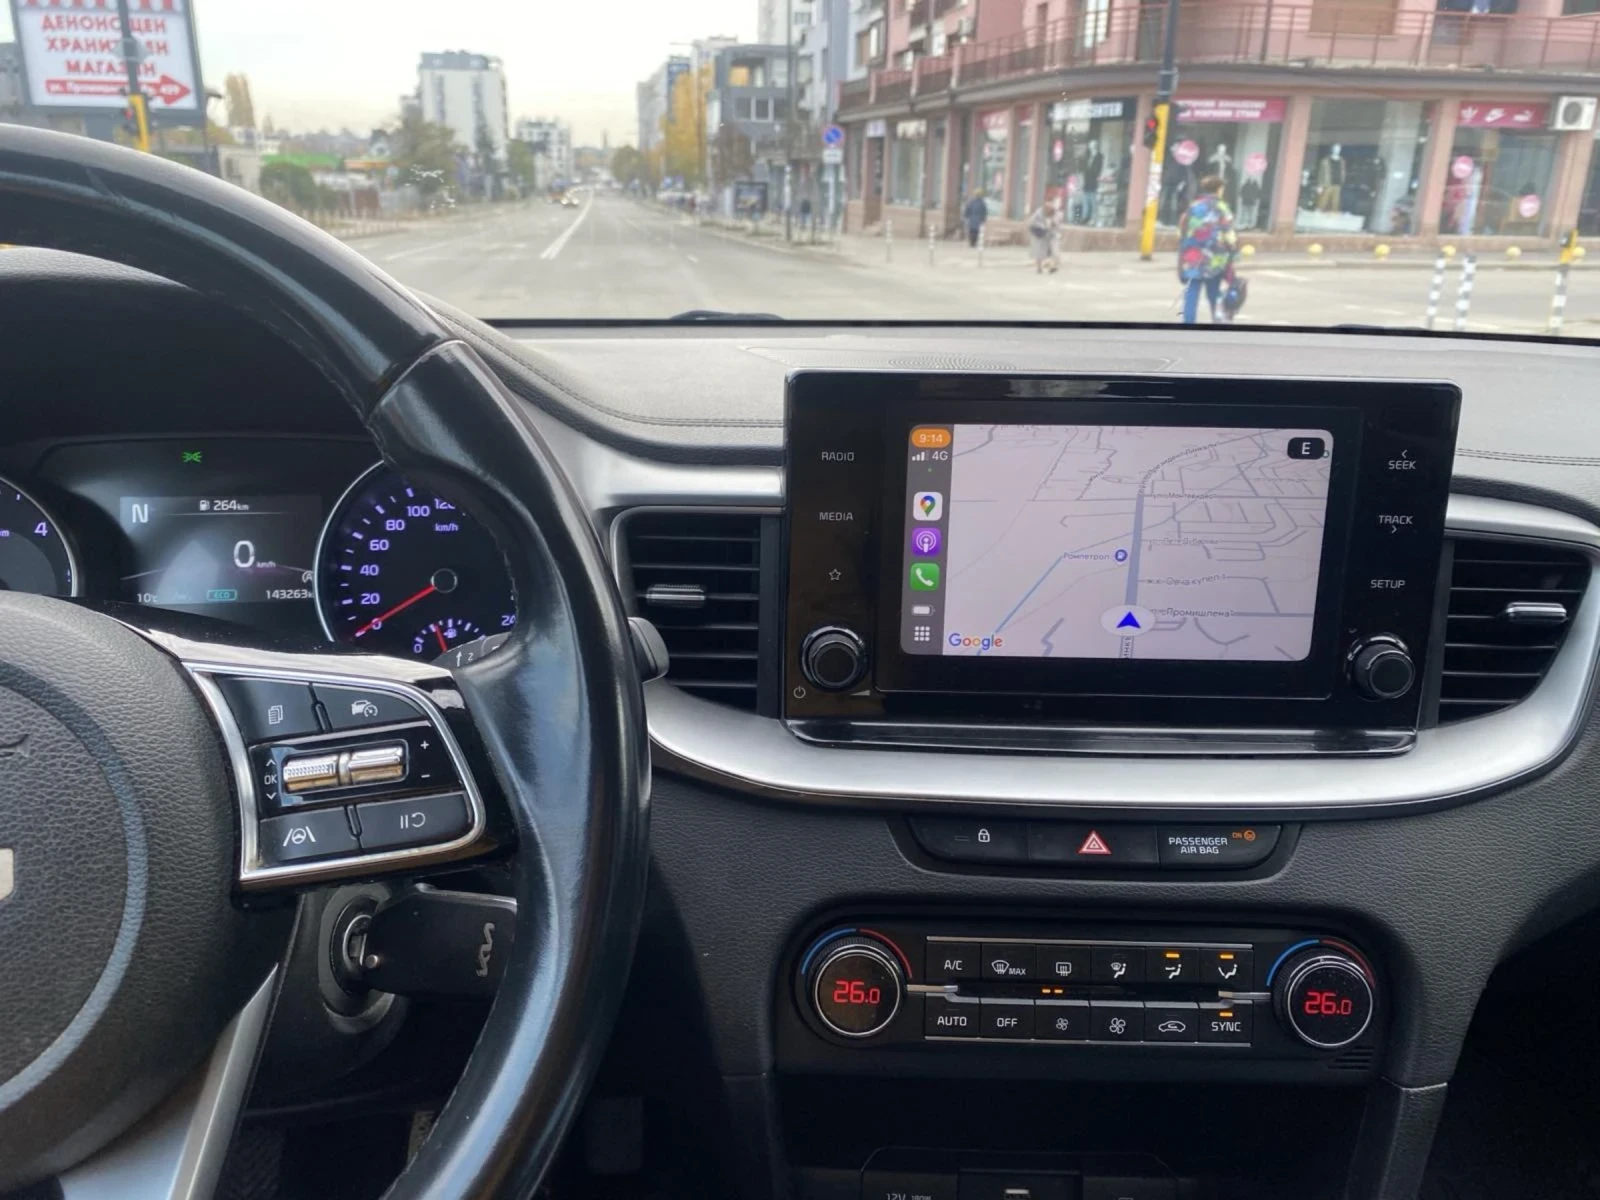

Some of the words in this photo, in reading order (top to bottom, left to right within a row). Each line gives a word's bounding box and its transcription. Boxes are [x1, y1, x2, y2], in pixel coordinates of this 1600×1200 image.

[919, 432, 943, 443] 9:14
[1302, 442, 1311, 454] E
[821, 451, 854, 461] RADIO
[931, 450, 948, 461] 4G
[1388, 460, 1416, 470] SEEK
[132, 503, 149, 523] N
[407, 505, 430, 517] 100
[819, 512, 853, 521] MEDIA
[385, 519, 405, 531] 80
[1379, 515, 1413, 525] TRACK
[34, 522, 48, 537] 4
[435, 523, 458, 532] km/h
[369, 539, 390, 551] 60
[233, 540, 255, 568] 0
[360, 564, 379, 576] 40
[1370, 579, 1406, 589] SETUP
[361, 592, 380, 605] 20
[948, 632, 1003, 650] Google
[264, 774, 278, 786] OK
[1169, 837, 1228, 846] PASSENGER
[1180, 847, 1197, 855] AIR
[1199, 847, 1219, 855] BAG
[944, 960, 962, 971] A/C
[1009, 967, 1026, 975] MAX
[833, 981, 880, 1004] 26.0
[1304, 991, 1352, 1015] 26.0
[937, 1016, 967, 1027] AUTO
[997, 1018, 1017, 1027] OFF
[1211, 1022, 1241, 1032] SYNC
